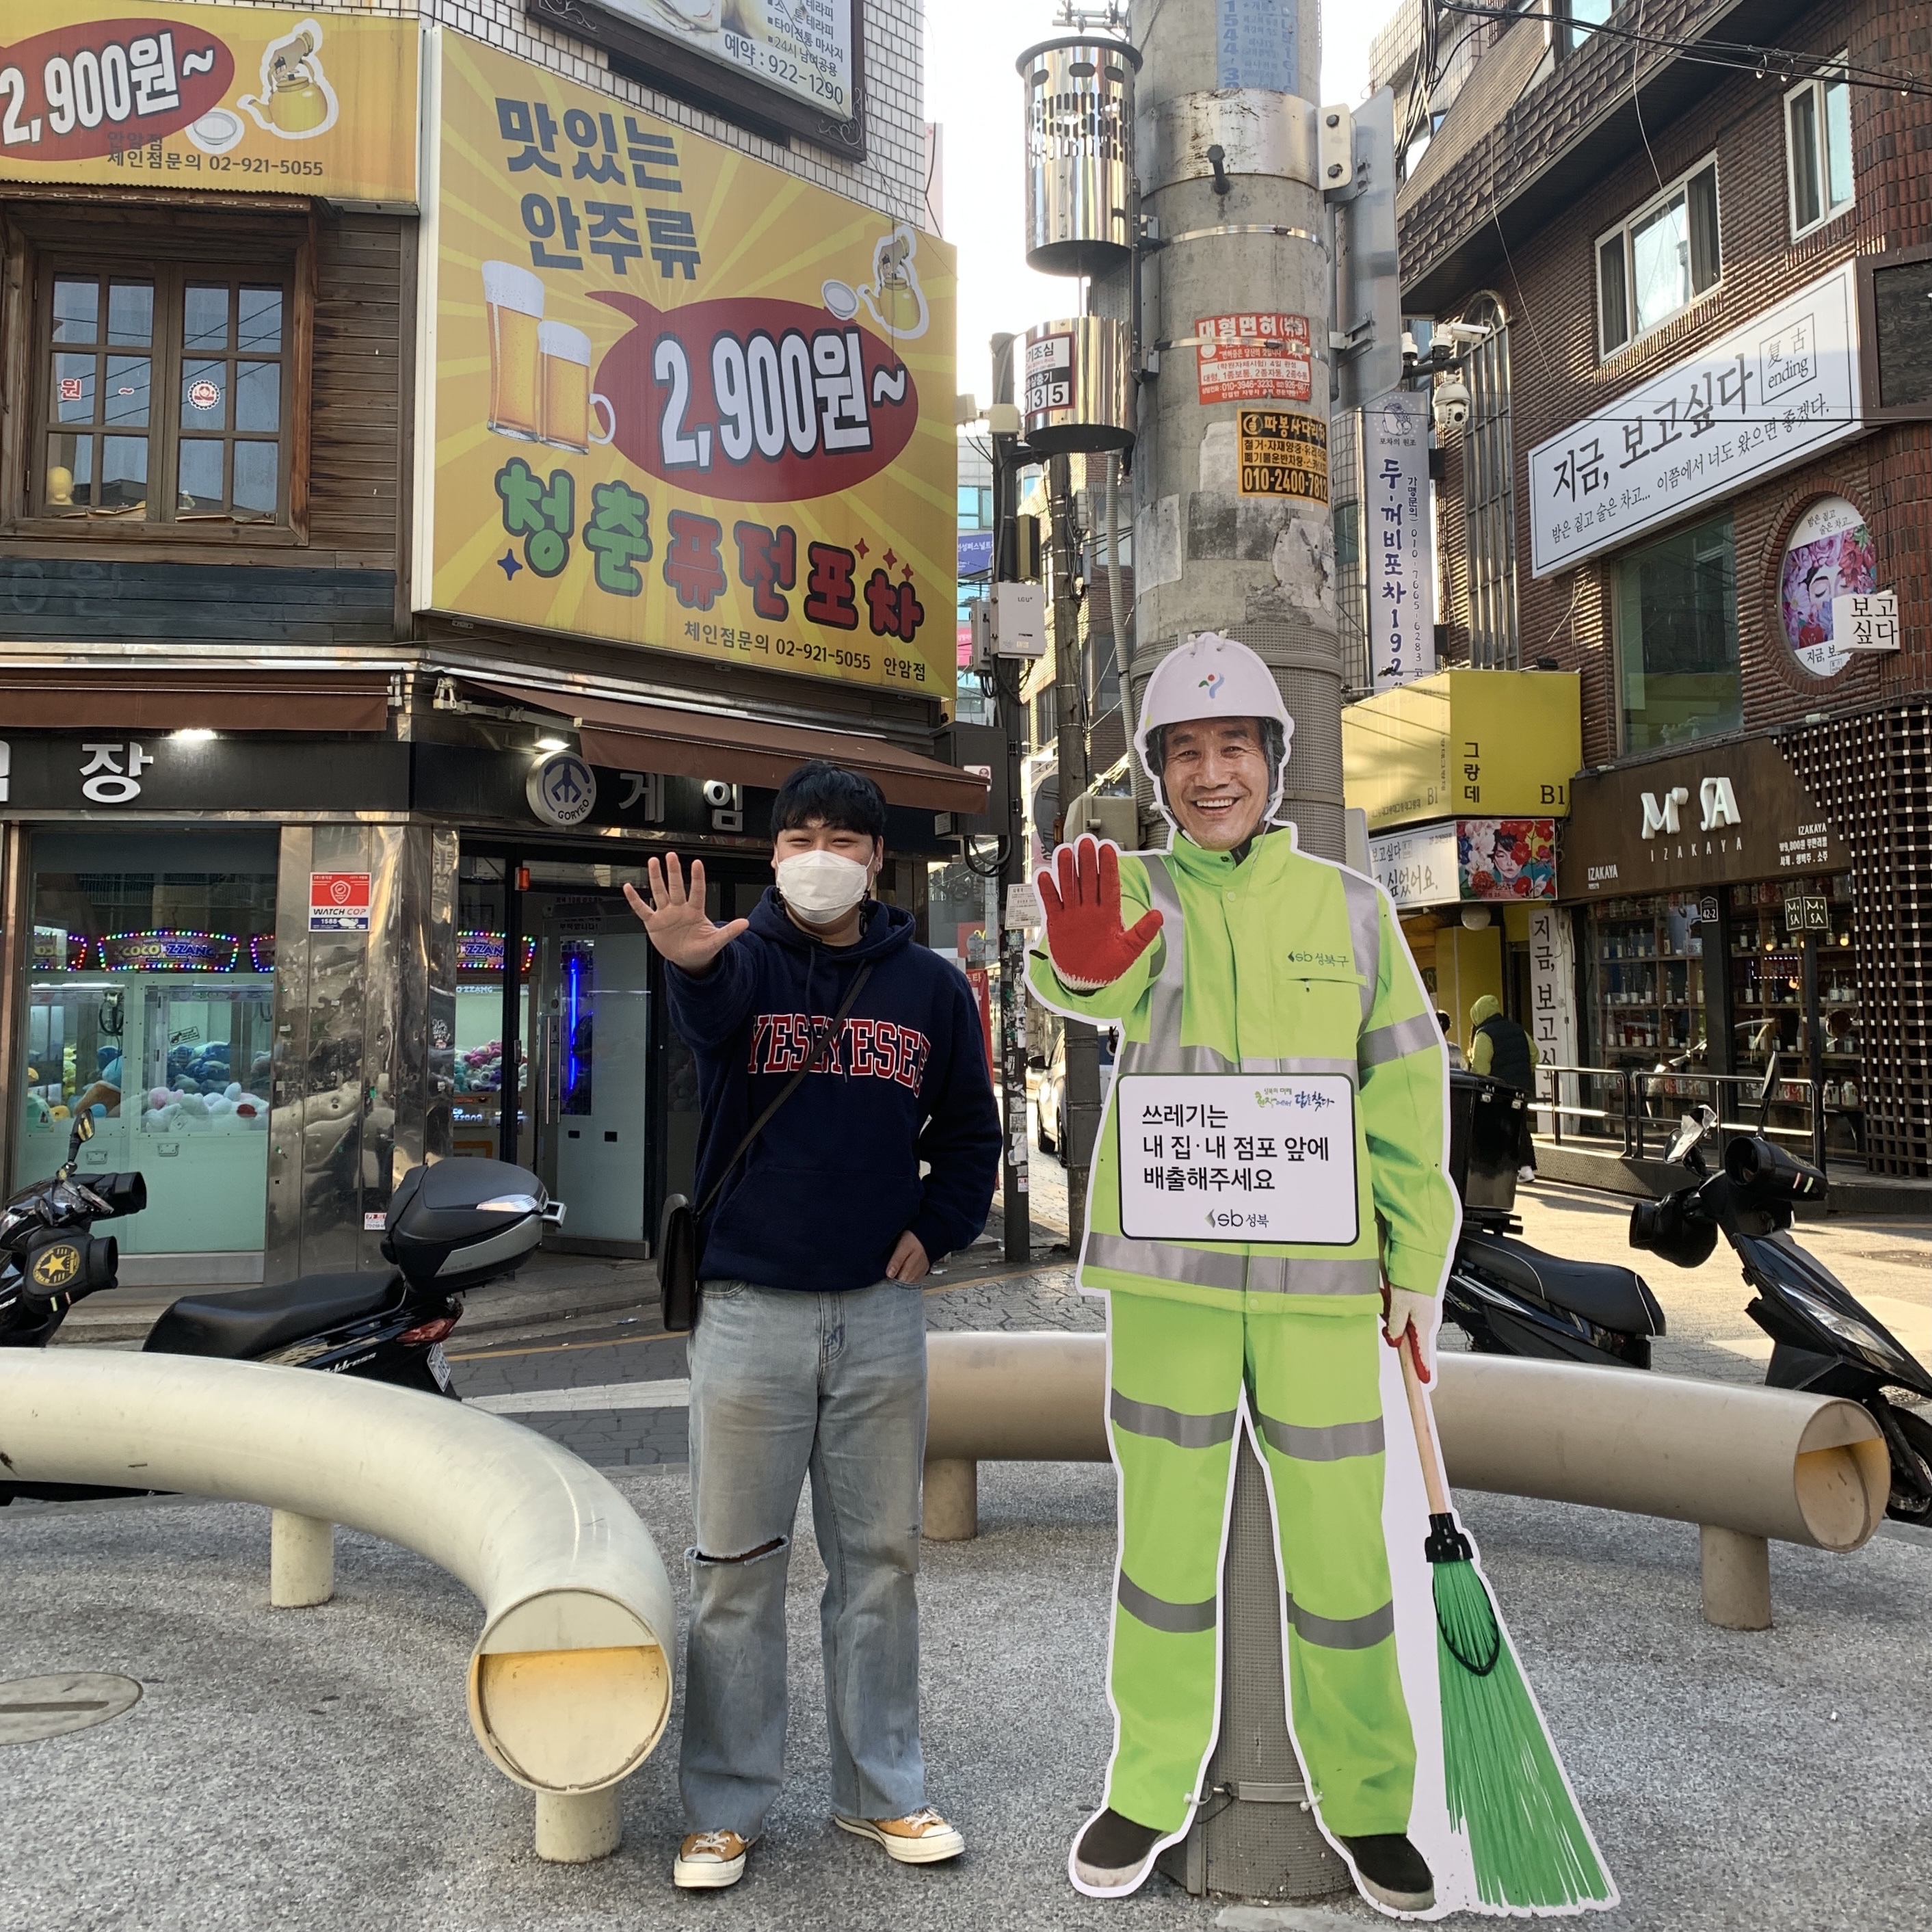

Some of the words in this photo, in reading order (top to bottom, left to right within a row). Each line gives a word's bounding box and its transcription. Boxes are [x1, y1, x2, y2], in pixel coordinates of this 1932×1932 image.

[806, 15, 834, 40] 테라피
[773, 36, 797, 58] 24시
[816, 38, 843, 62] 마사지
[725, 34, 756, 66] 예약
[768, 54, 843, 105] 922-1290
[495, 97, 683, 193] 맛있는
[209, 155, 323, 176] 02-921-5055
[520, 193, 701, 280] 안주류
[1768, 357, 1809, 388] ending
[61, 378, 81, 401] 원
[652, 330, 906, 468] 2,900원~
[1553, 438, 1609, 503] 지금,
[1619, 354, 1754, 469] 보고싶다
[1379, 437, 1401, 447] 포차의
[1403, 438, 1417, 447] 원조
[1244, 467, 1327, 501] 010-2400-7812
[1552, 520, 1571, 544] 밤은
[1596, 497, 1617, 523] 술은
[1657, 453, 1704, 492] 이쯤에서
[1708, 441, 1734, 467] 너도
[1738, 416, 1777, 457] 왔으면
[1807, 515, 1820, 528] 밤은
[494, 457, 653, 597] 청춘
[663, 509, 925, 643] 퓨전포차
[1850, 596, 1897, 618] 보고
[1853, 620, 1898, 646] 싶다
[685, 620, 769, 654] 체인점문의
[776, 637, 871, 670] 02-921-5055
[884, 657, 926, 683] 안암점
[1807, 647, 1825, 665] 지금,
[1464, 742, 1480, 803] 그랑데
[1427, 786, 1439, 806] B1
[1540, 784, 1565, 805] B1
[557, 799, 590, 820] GORYEO
[1798, 822, 1827, 836] IZAKAYA
[1650, 836, 1743, 862] IZAKAYA
[1587, 864, 1618, 882] IZAKAYA
[1702, 908, 1717, 919] 42-2
[1810, 912, 1824, 924] SA
[121, 944, 160, 957] COCO
[166, 943, 215, 957] ZZANG
[1534, 916, 1555, 972] 지금,
[1314, 953, 1349, 968] 성북구
[1142, 1104, 1228, 1128] 쓰레기는
[1143, 1135, 1163, 1159] 내
[1233, 1136, 1278, 1161] 점포
[1284, 1137, 1329, 1162] 앞에
[1143, 1166, 1275, 1192] 배출해주세요
[1245, 1213, 1269, 1228] 성북
